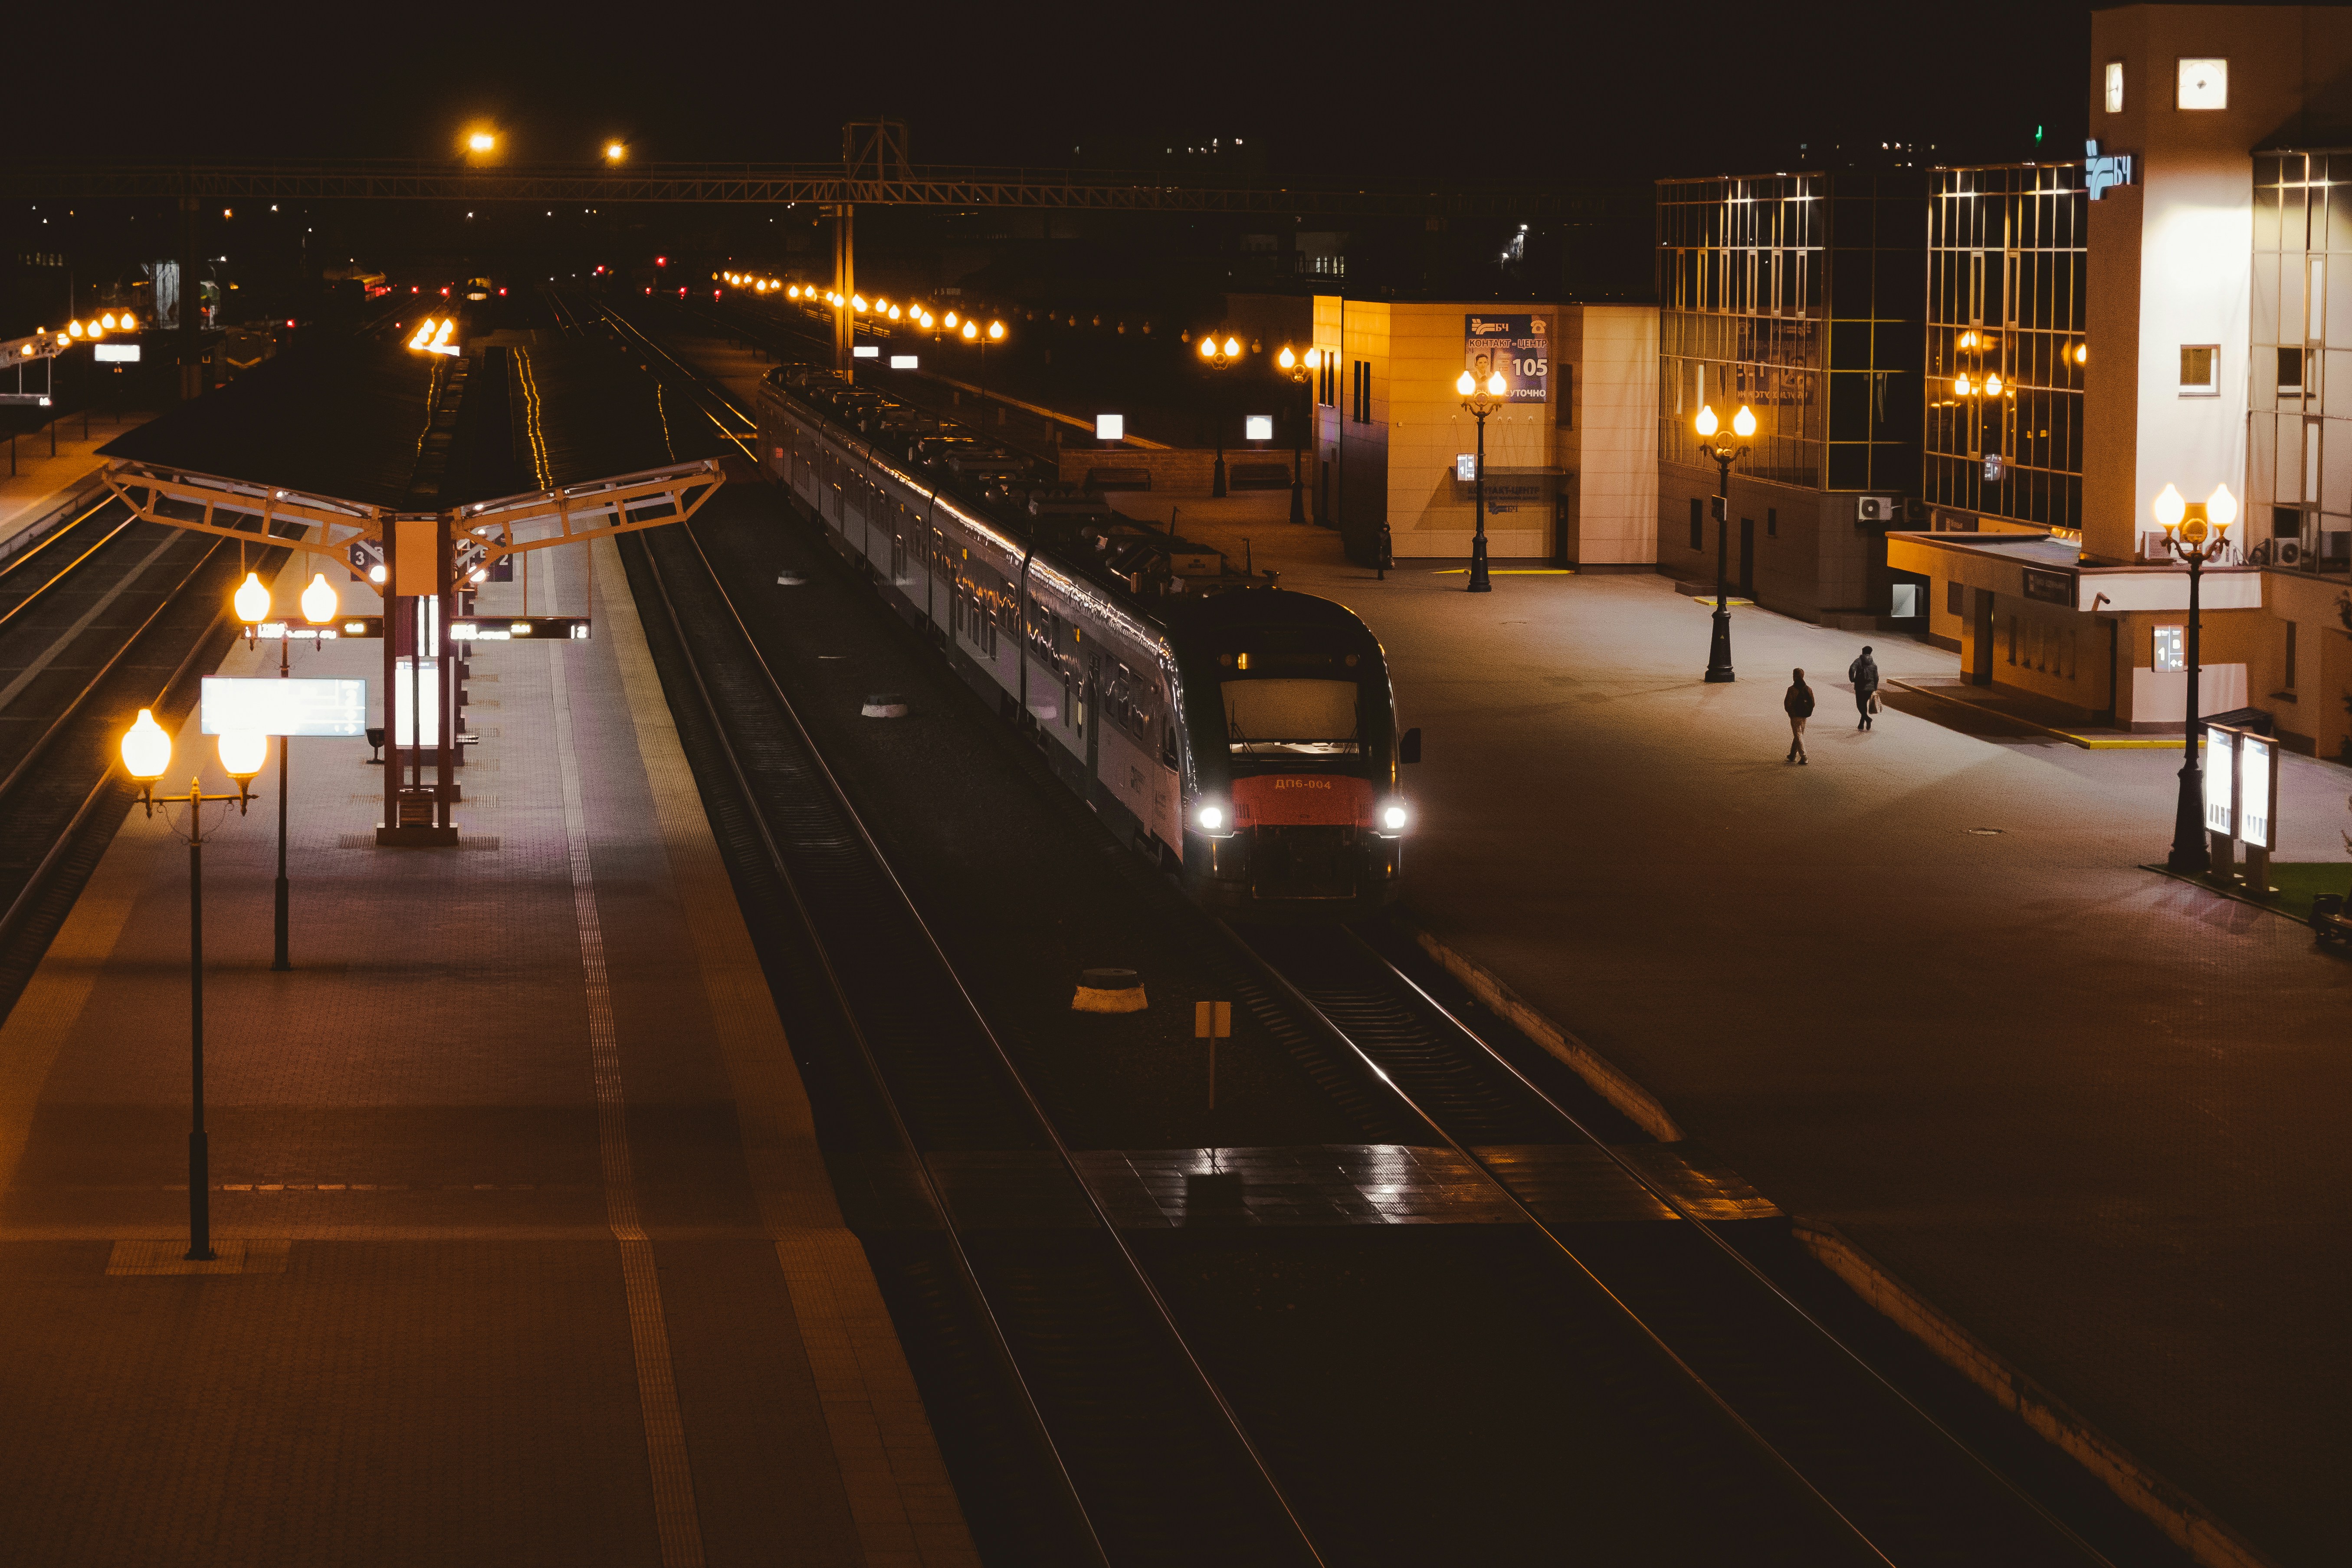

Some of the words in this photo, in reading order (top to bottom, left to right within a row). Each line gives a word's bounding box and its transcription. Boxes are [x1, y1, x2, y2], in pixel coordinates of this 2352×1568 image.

[2114, 155, 2131, 185] БЧ
[1512, 358, 1548, 377] 105
[355, 551, 365, 566] 3
[2158, 647, 2165, 661] 1
[1275, 779, 1331, 790] ДП6-004
